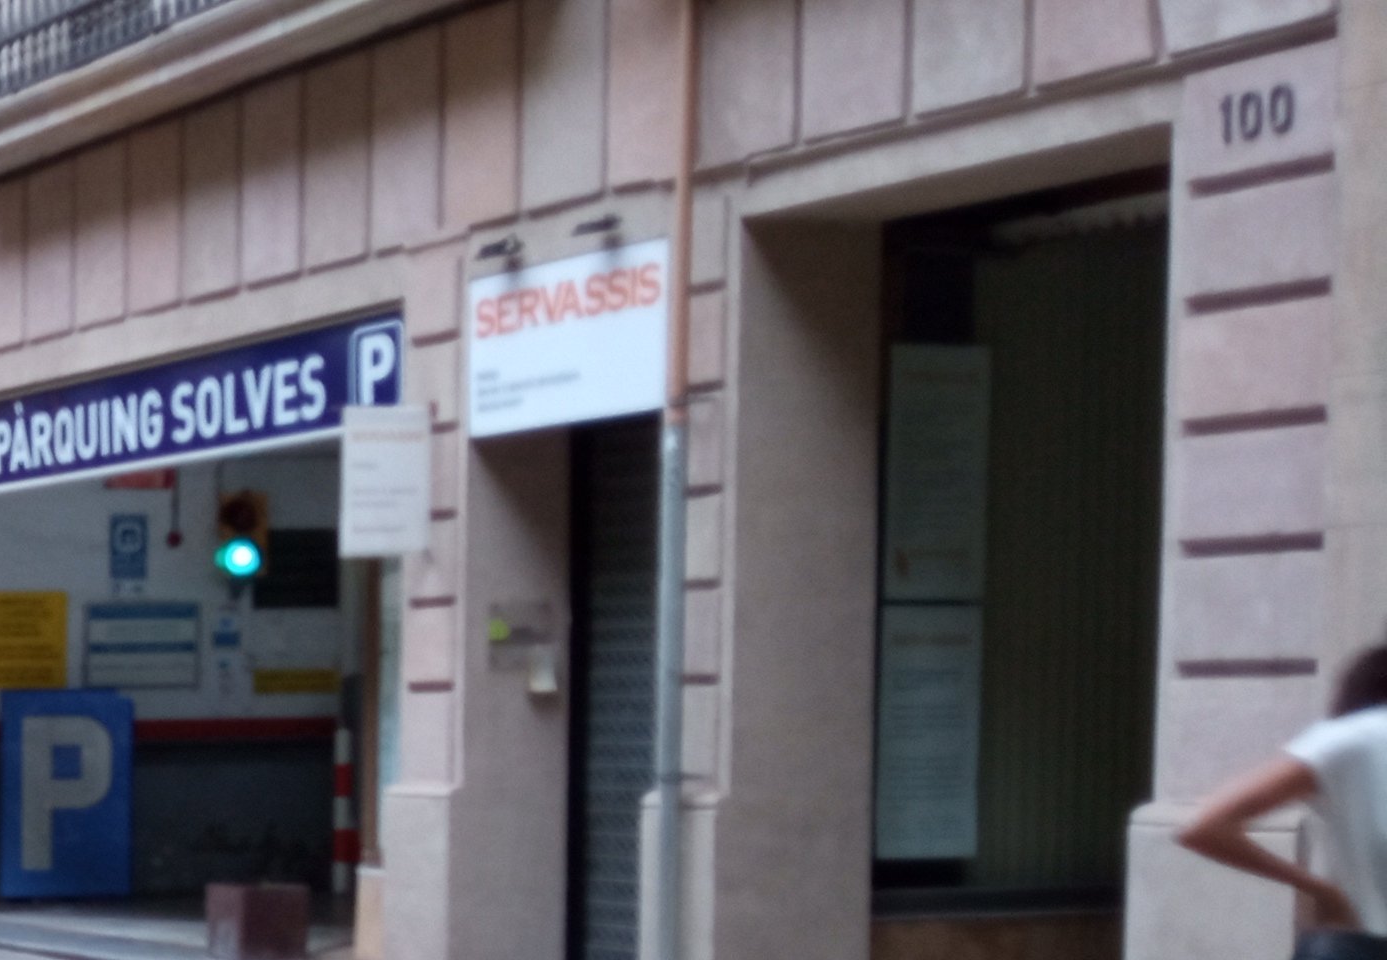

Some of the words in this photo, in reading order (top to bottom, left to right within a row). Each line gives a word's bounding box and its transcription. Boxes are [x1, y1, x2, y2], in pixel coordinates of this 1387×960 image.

[1219, 84, 1294, 145] 100
[476, 262, 661, 339] SERVASSIS
[170, 353, 326, 443] SOLVES
[358, 333, 395, 406] P
[21, 715, 113, 869] P
